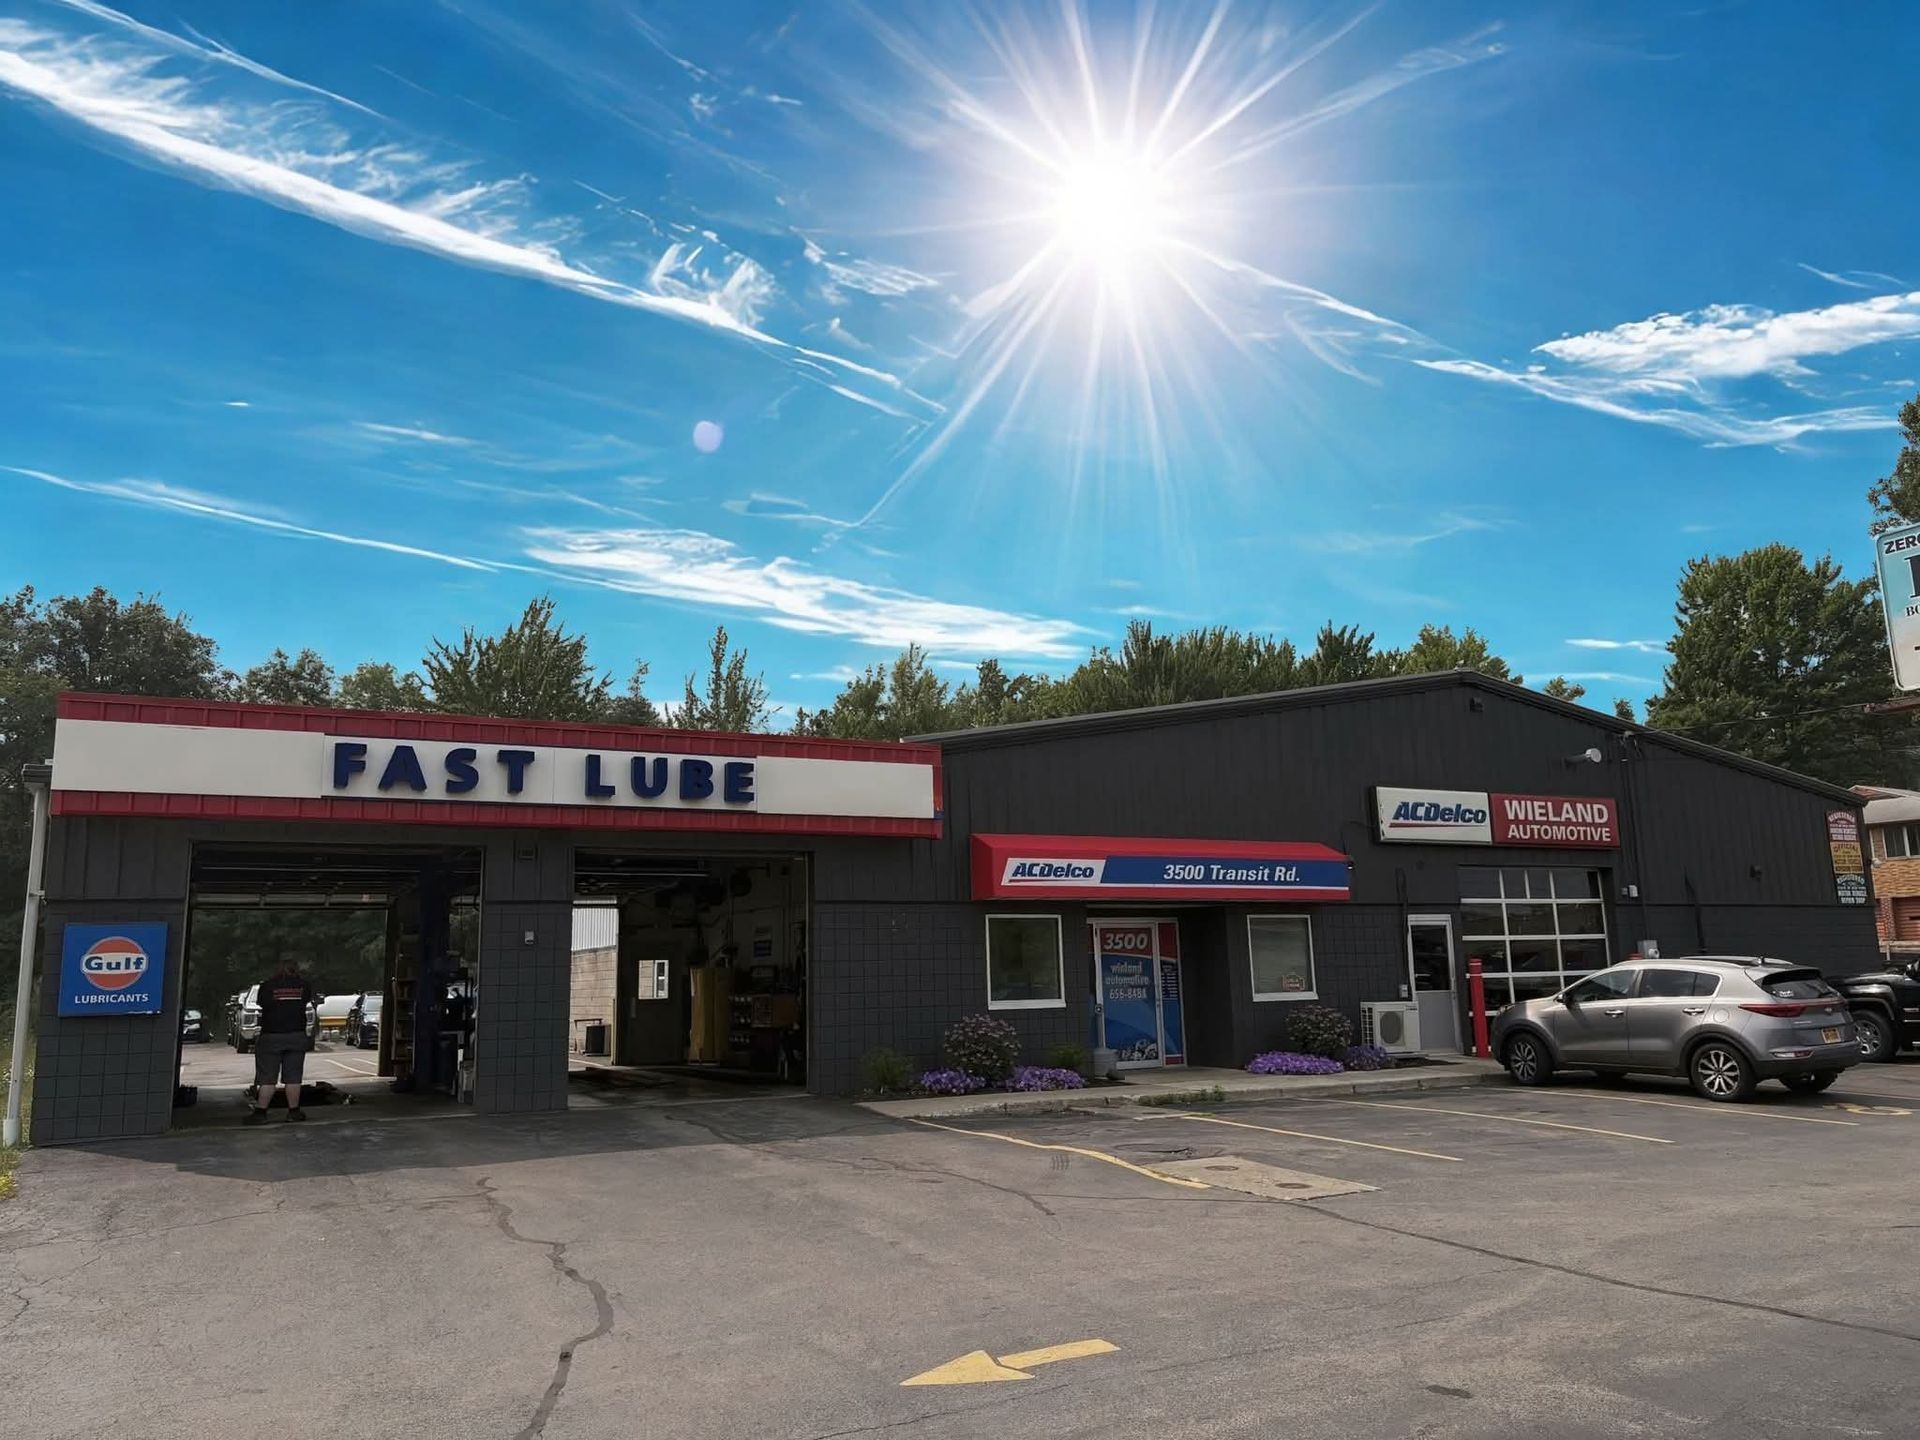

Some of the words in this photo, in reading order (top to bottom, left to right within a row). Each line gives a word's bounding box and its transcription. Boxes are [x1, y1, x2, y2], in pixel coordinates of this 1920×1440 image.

[333, 742, 535, 794] FAST
[585, 754, 755, 803] LUBE
[1392, 801, 1487, 824] ACDelco
[1504, 799, 1609, 823] WIELAND
[1507, 824, 1611, 842] AUTOMOTIVE
[1012, 862, 1094, 879] ACDelco
[1163, 864, 1202, 880] 3500
[1210, 865, 1270, 881] Transit
[1275, 866, 1301, 882] Rd.
[1103, 932, 1149, 950] 3500
[84, 955, 145, 971] Gulf
[74, 993, 149, 1004] LUBRICANTS
